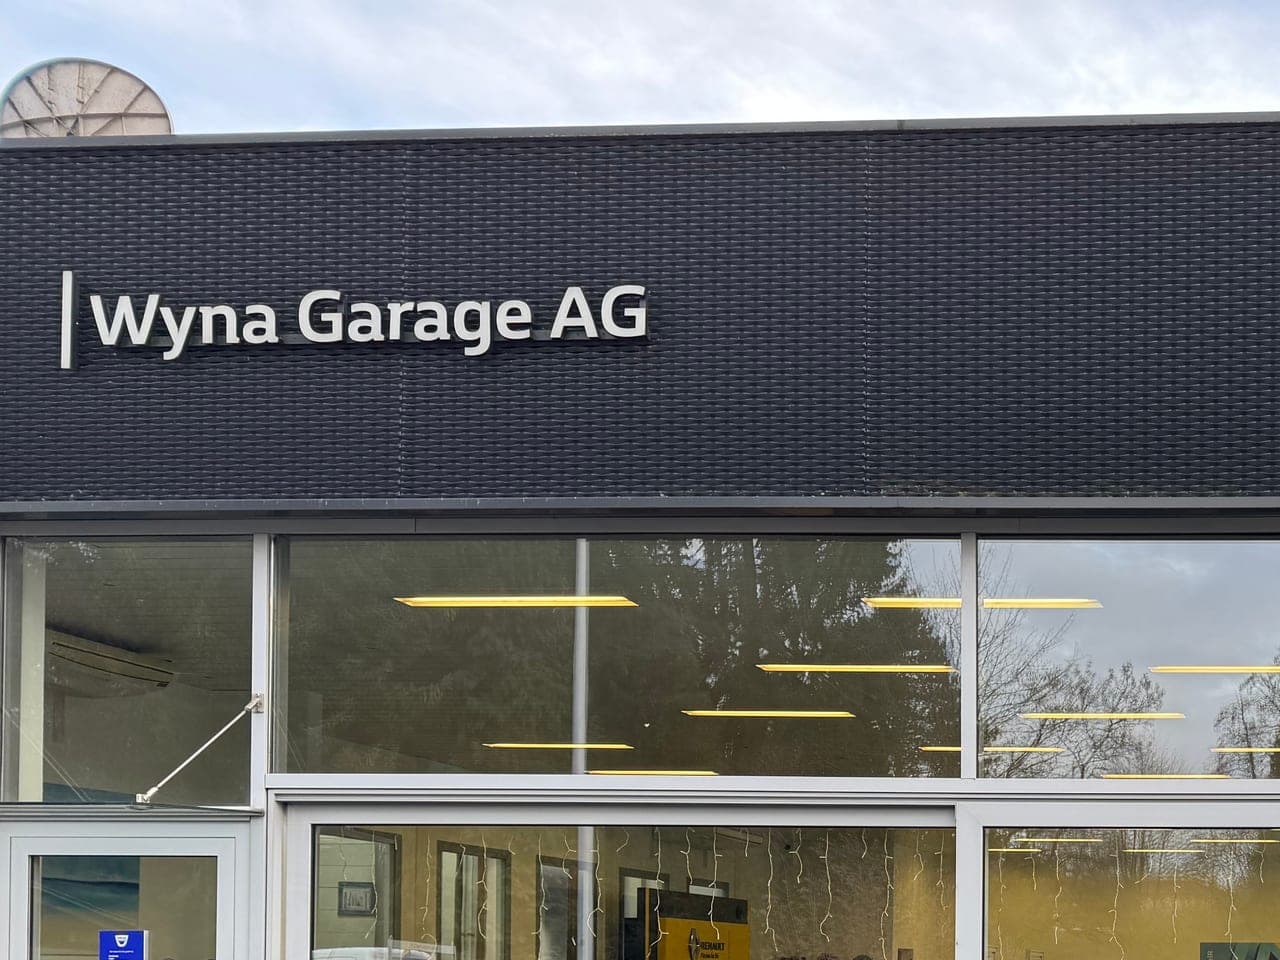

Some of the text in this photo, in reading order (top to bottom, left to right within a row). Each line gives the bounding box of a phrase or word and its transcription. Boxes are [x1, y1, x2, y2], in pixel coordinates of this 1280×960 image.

[90, 285, 648, 361] Wyna Garage AG
